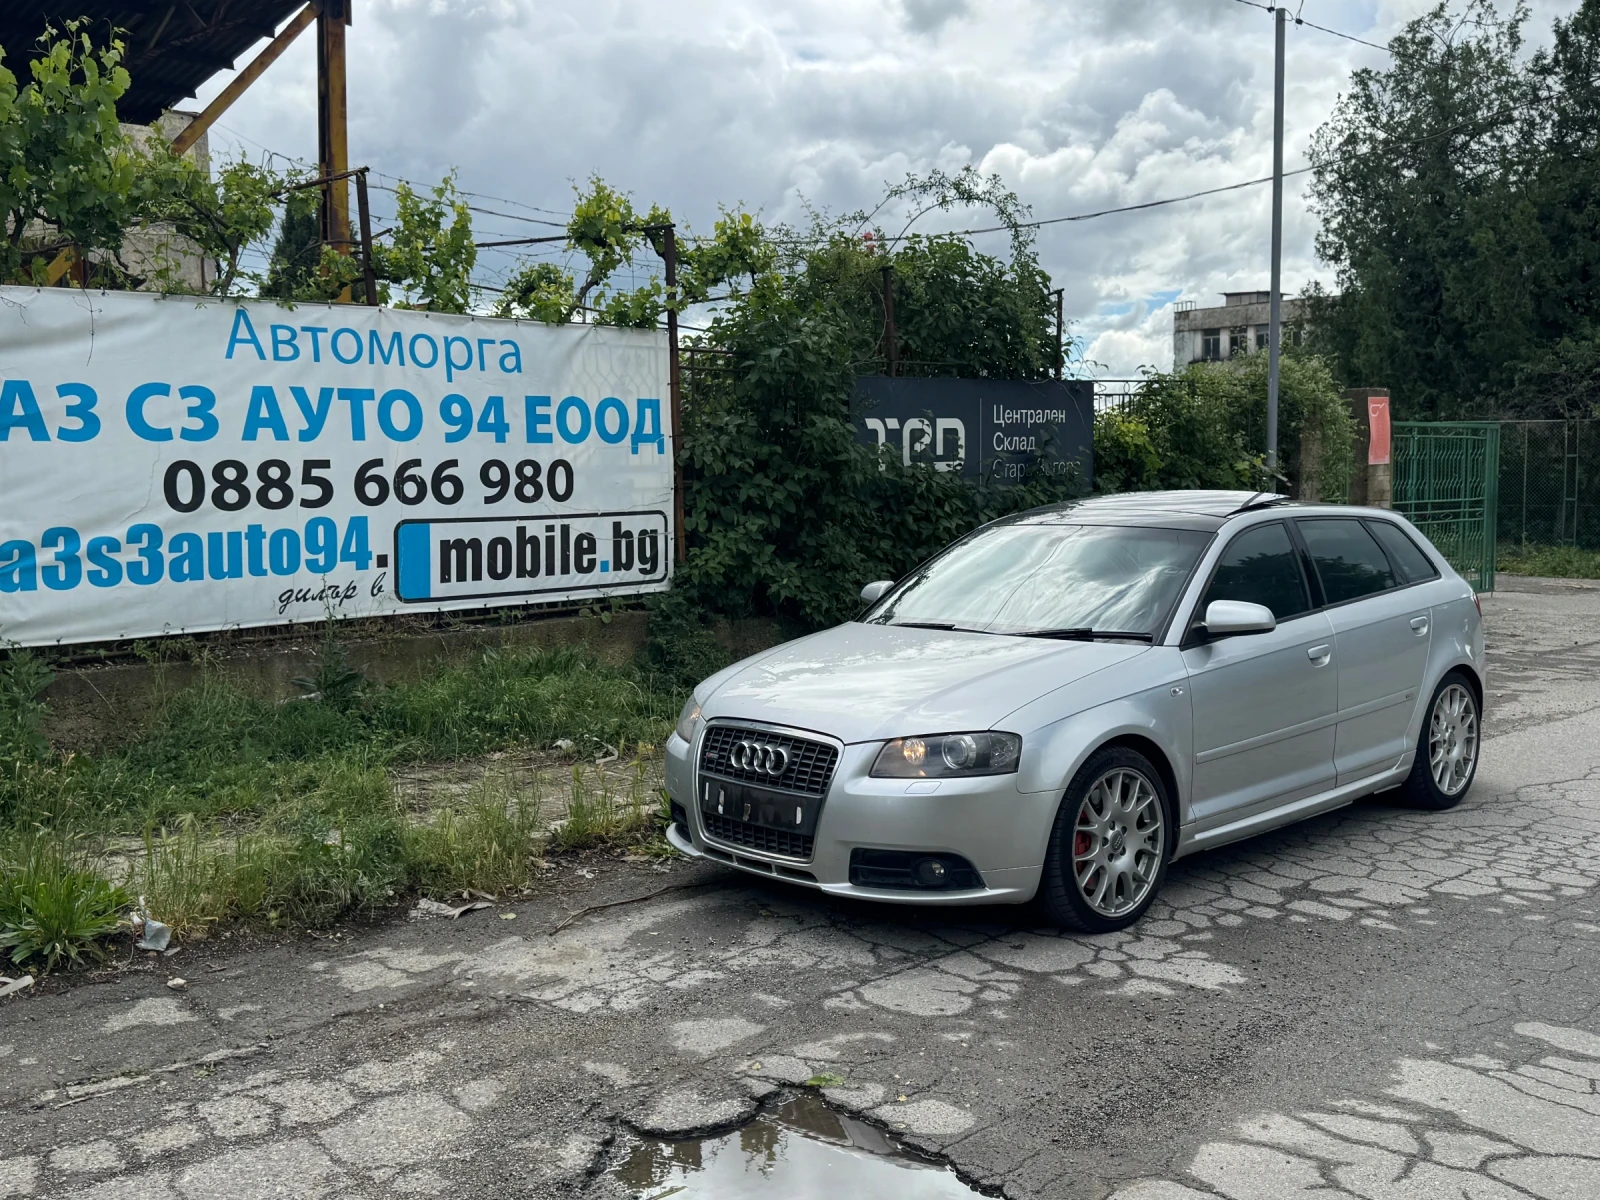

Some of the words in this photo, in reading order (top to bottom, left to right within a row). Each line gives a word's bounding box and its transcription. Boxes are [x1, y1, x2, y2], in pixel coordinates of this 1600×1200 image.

[225, 309, 523, 384] Автоморга
[241, 384, 424, 443] АУТО
[438, 392, 511, 445] 94
[524, 394, 665, 456] ЕООД
[993, 404, 1066, 428] Централен
[993, 432, 1036, 453] Склад
[163, 458, 334, 513] 0885
[353, 458, 464, 507] 666
[479, 458, 574, 505] 980
[439, 521, 660, 584] mobile.bg
[278, 580, 358, 615] дилър
[370, 571, 387, 598] в
